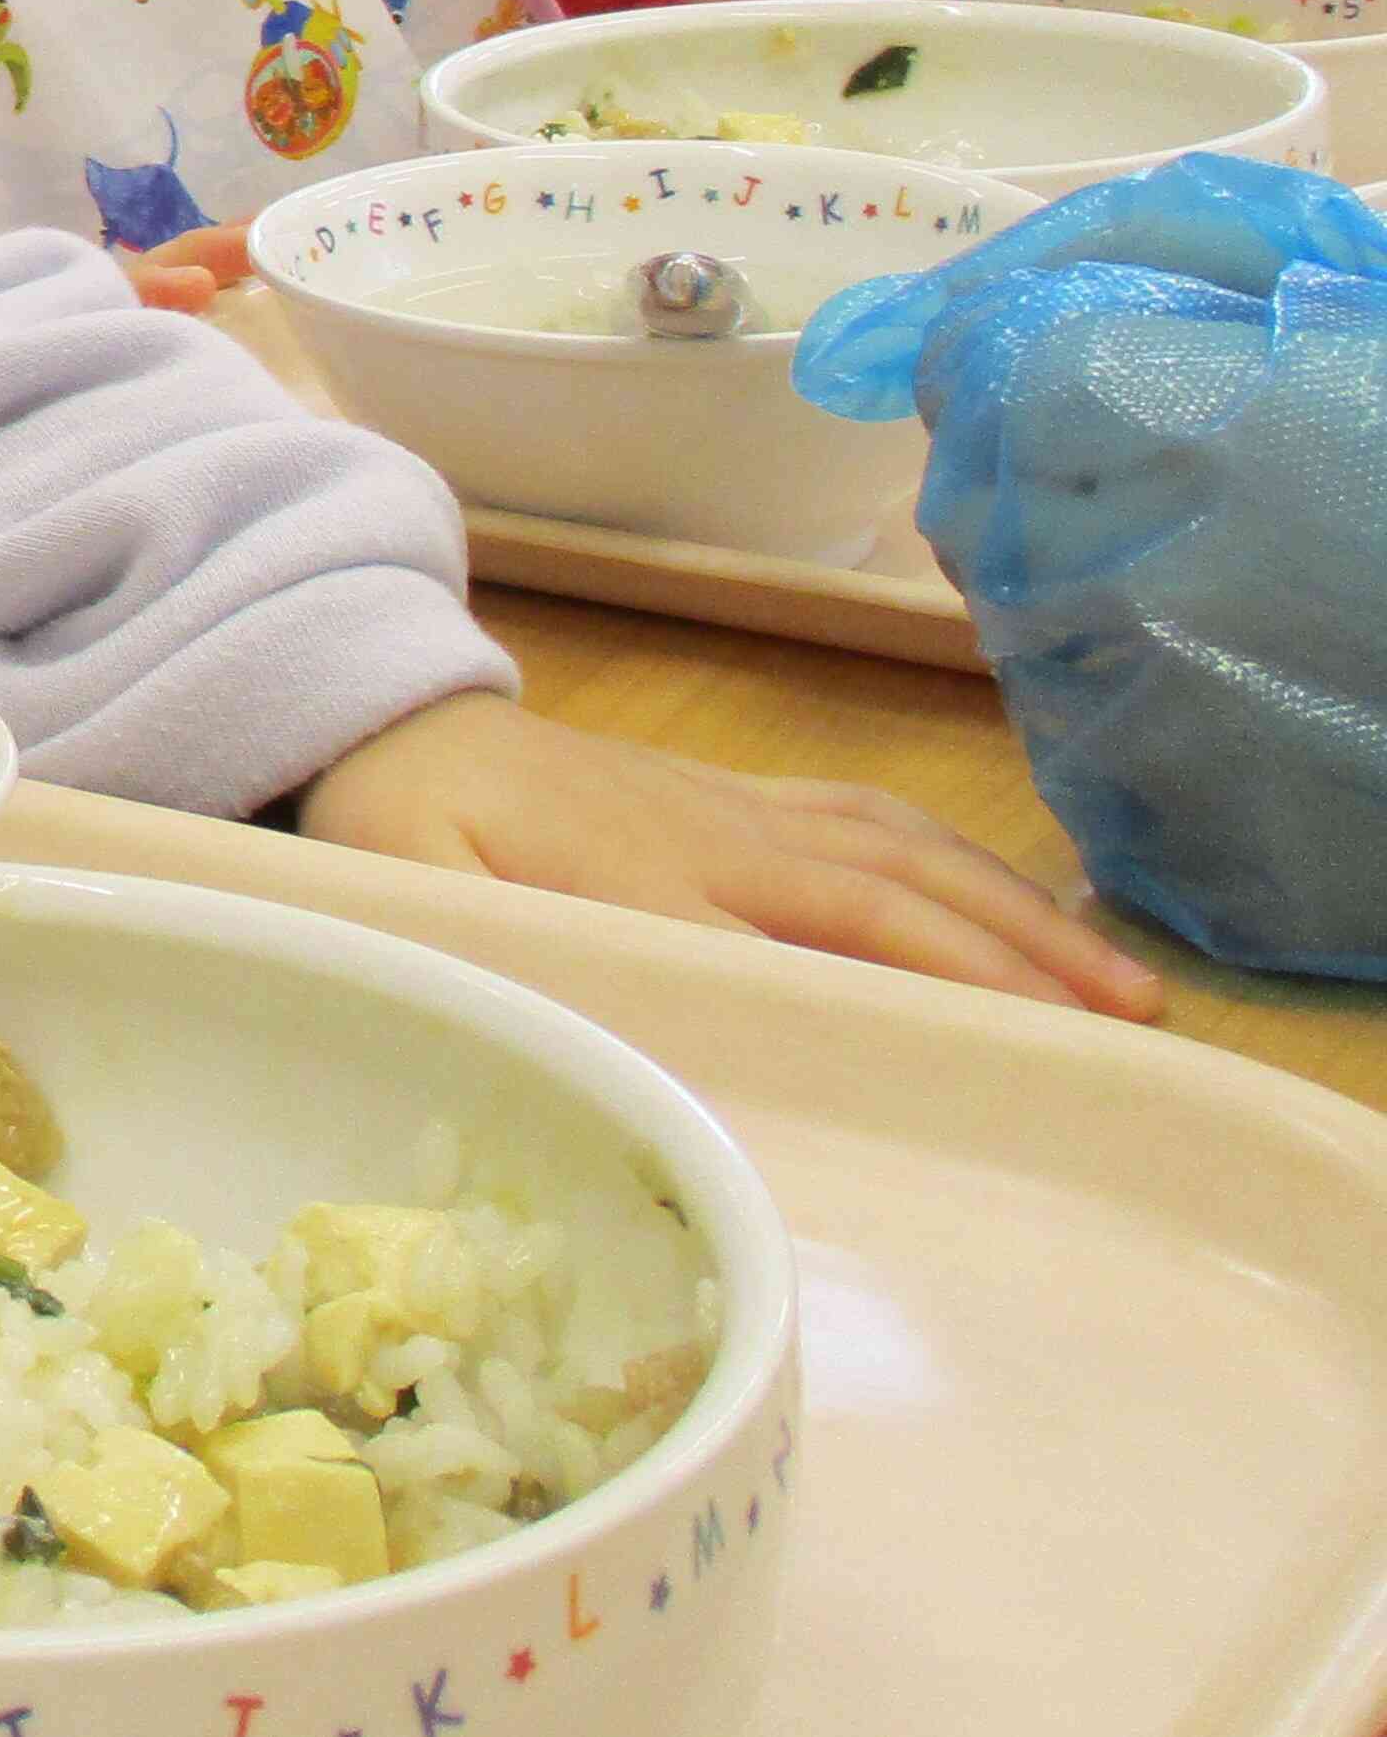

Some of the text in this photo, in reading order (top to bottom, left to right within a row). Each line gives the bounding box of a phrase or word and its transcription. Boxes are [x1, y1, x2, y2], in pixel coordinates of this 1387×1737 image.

[315, 167, 980, 254] D E F G H I J K L M
[409, 1668, 465, 1737] K
[565, 1574, 602, 1641] L
